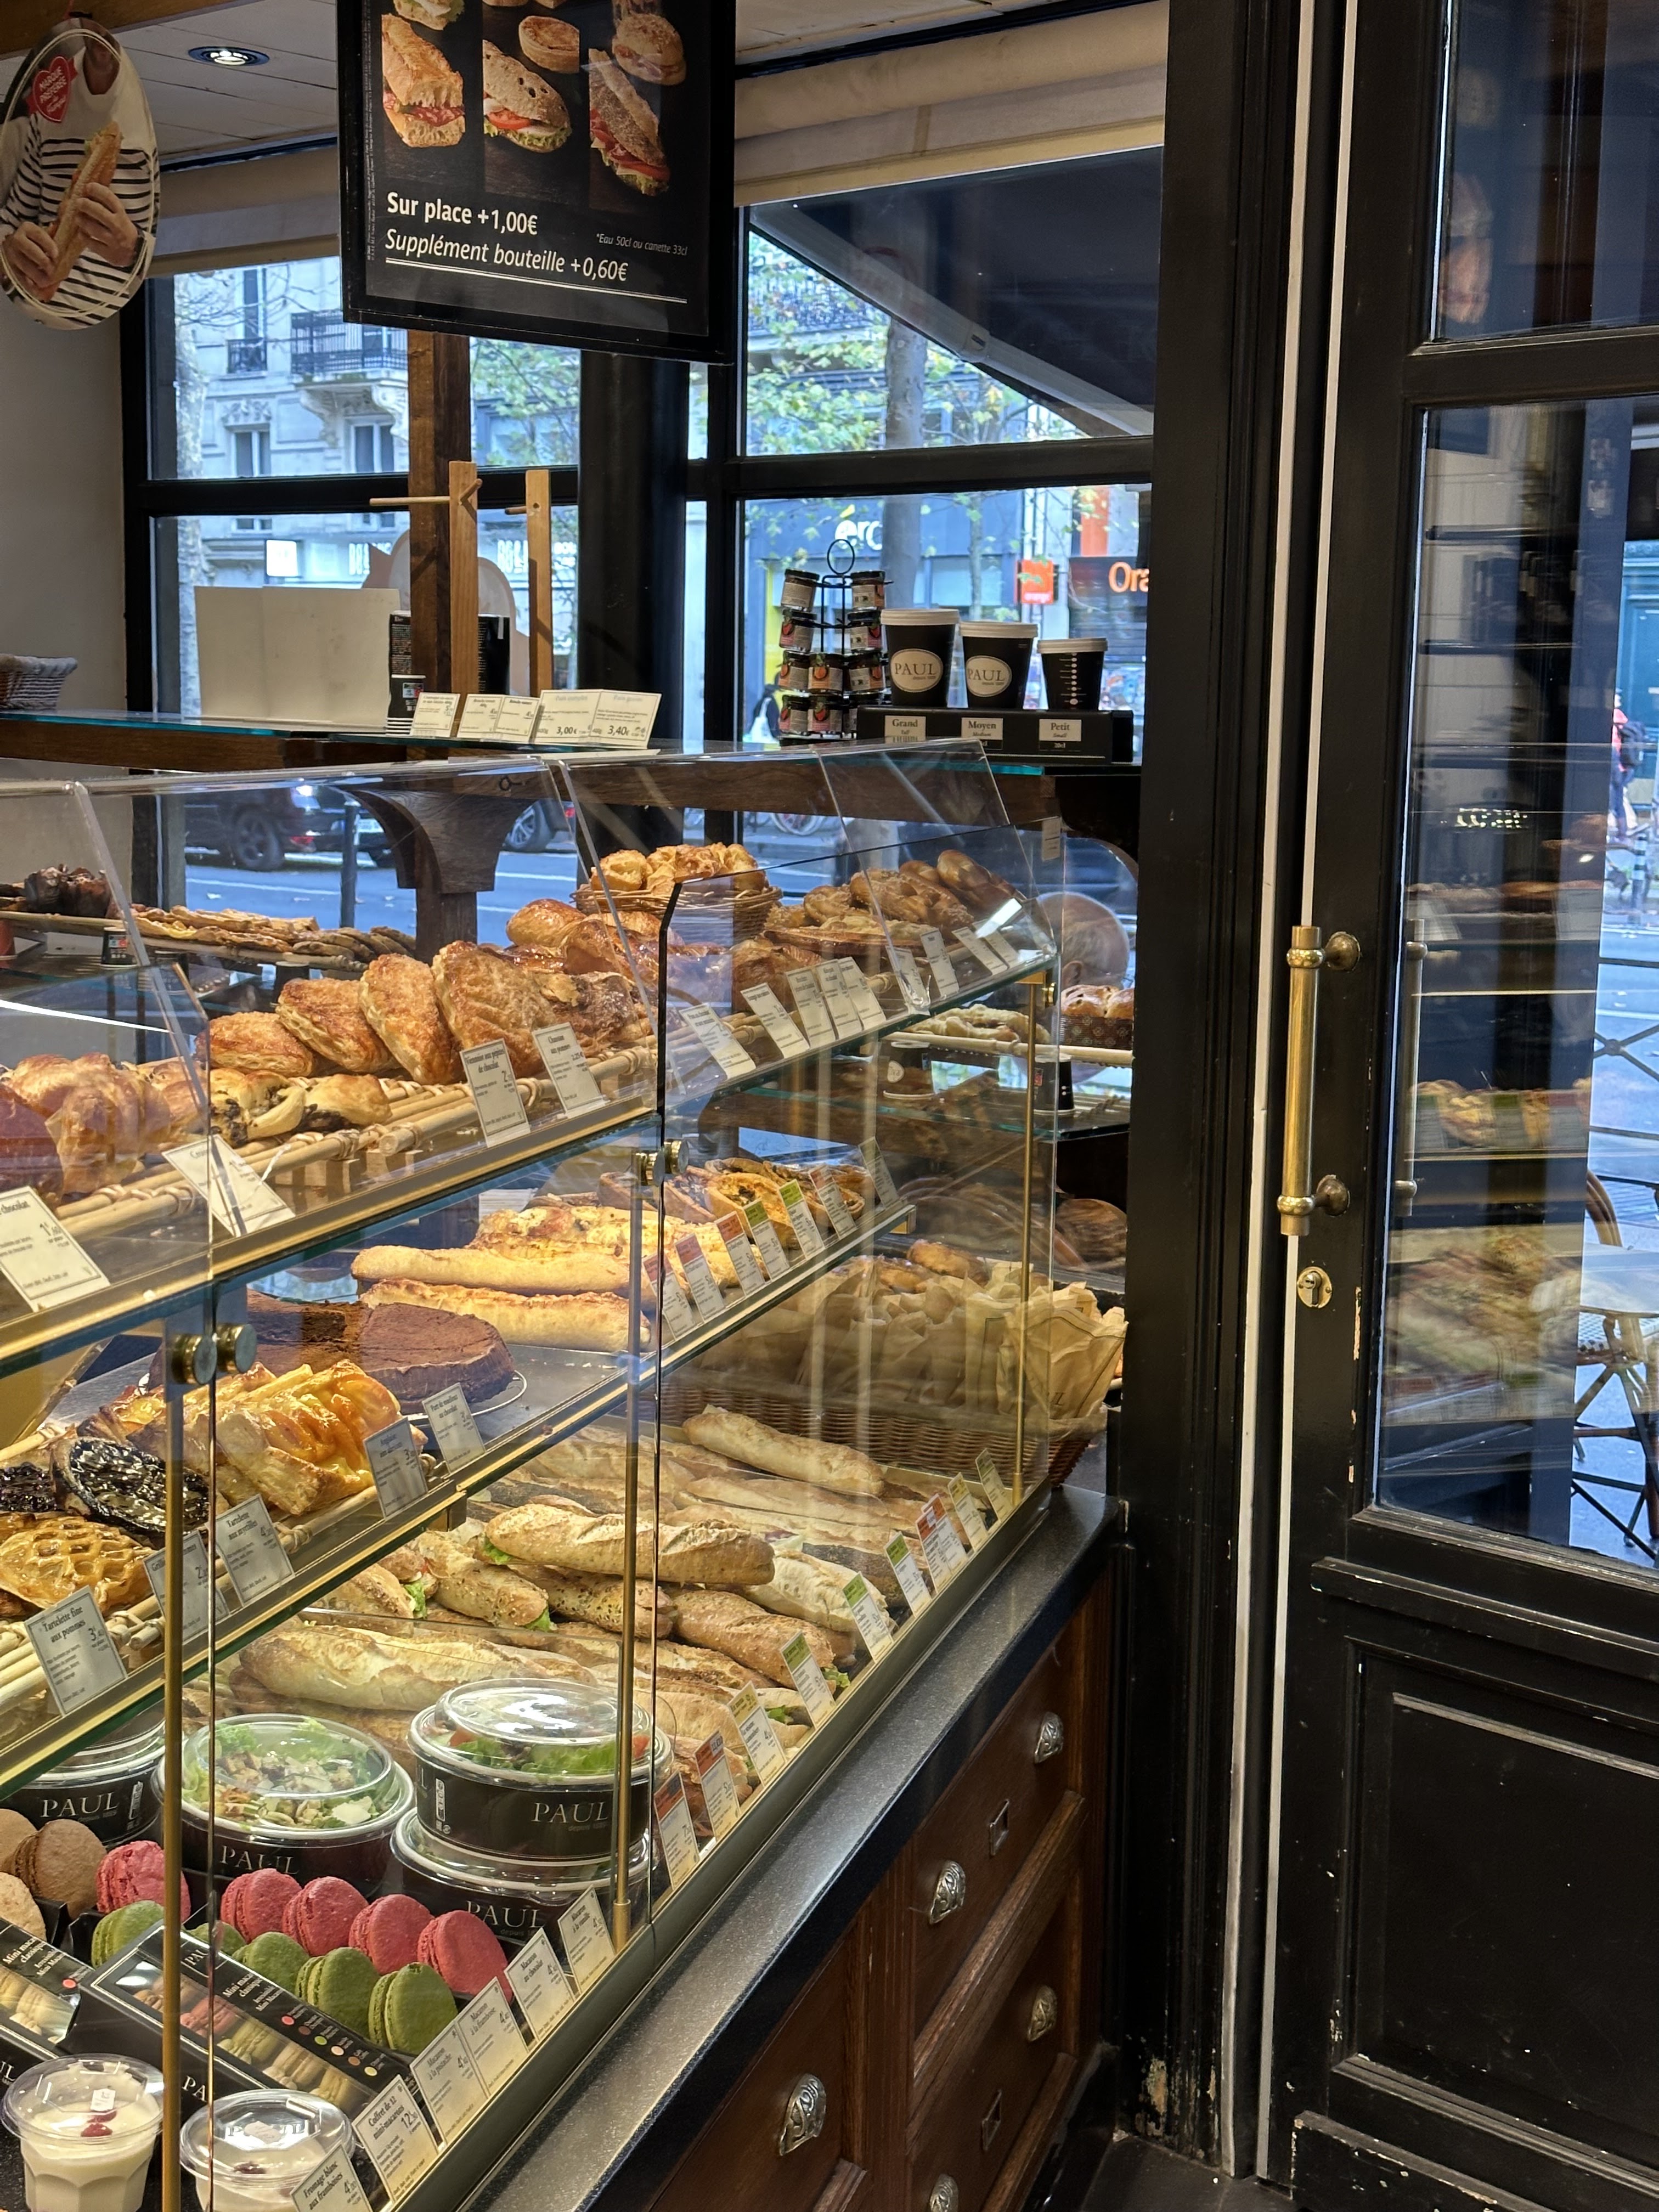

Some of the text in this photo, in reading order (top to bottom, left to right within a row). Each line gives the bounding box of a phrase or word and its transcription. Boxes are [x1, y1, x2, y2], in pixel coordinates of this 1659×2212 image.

[387, 192, 419, 216] Sur
[425, 198, 472, 224] place
[385, 228, 489, 262] Supplément
[494, 244, 565, 272] bouteille
[616, 236, 631, 247] 50cl
[633, 240, 642, 249] ou
[645, 242, 671, 253] canette
[673, 245, 688, 256] 33cl
[895, 663, 937, 675] PAUL
[967, 668, 1005, 681] PAUL
[892, 719, 918, 728] Grand
[968, 720, 997, 730] Moyen
[1051, 722, 1071, 731] Petit
[227, 1510, 249, 1527] Tartelette
[228, 1519, 258, 1540] aux myrtilles
[43, 1604, 83, 1632] Tartelette fine
[50, 1618, 86, 1643] aux pommes
[41, 1792, 120, 1818] PAUL
[531, 1802, 608, 1823] PAUL
[220, 1846, 299, 1875] PAUL
[466, 1900, 545, 1928] PAUL
[572, 1903, 585, 1921] Macaron
[3, 1949, 22, 1964] Mini
[521, 1950, 536, 1971] Macaron
[36, 1965, 52, 1976] Mini
[524, 1957, 543, 1983] au chocolat
[223, 1982, 240, 1997] Mini
[471, 2000, 487, 2022] Macaron
[478, 2005, 495, 2028] framboise
[428, 2046, 444, 2067] Macaron
[436, 2053, 452, 2073] pistache
[368, 2095, 396, 2128] Coffret de 12
[374, 2105, 403, 2138] mini-macarons
[304, 2160, 337, 2199] Fromage blanc
[309, 2171, 342, 2209] aux framboises
